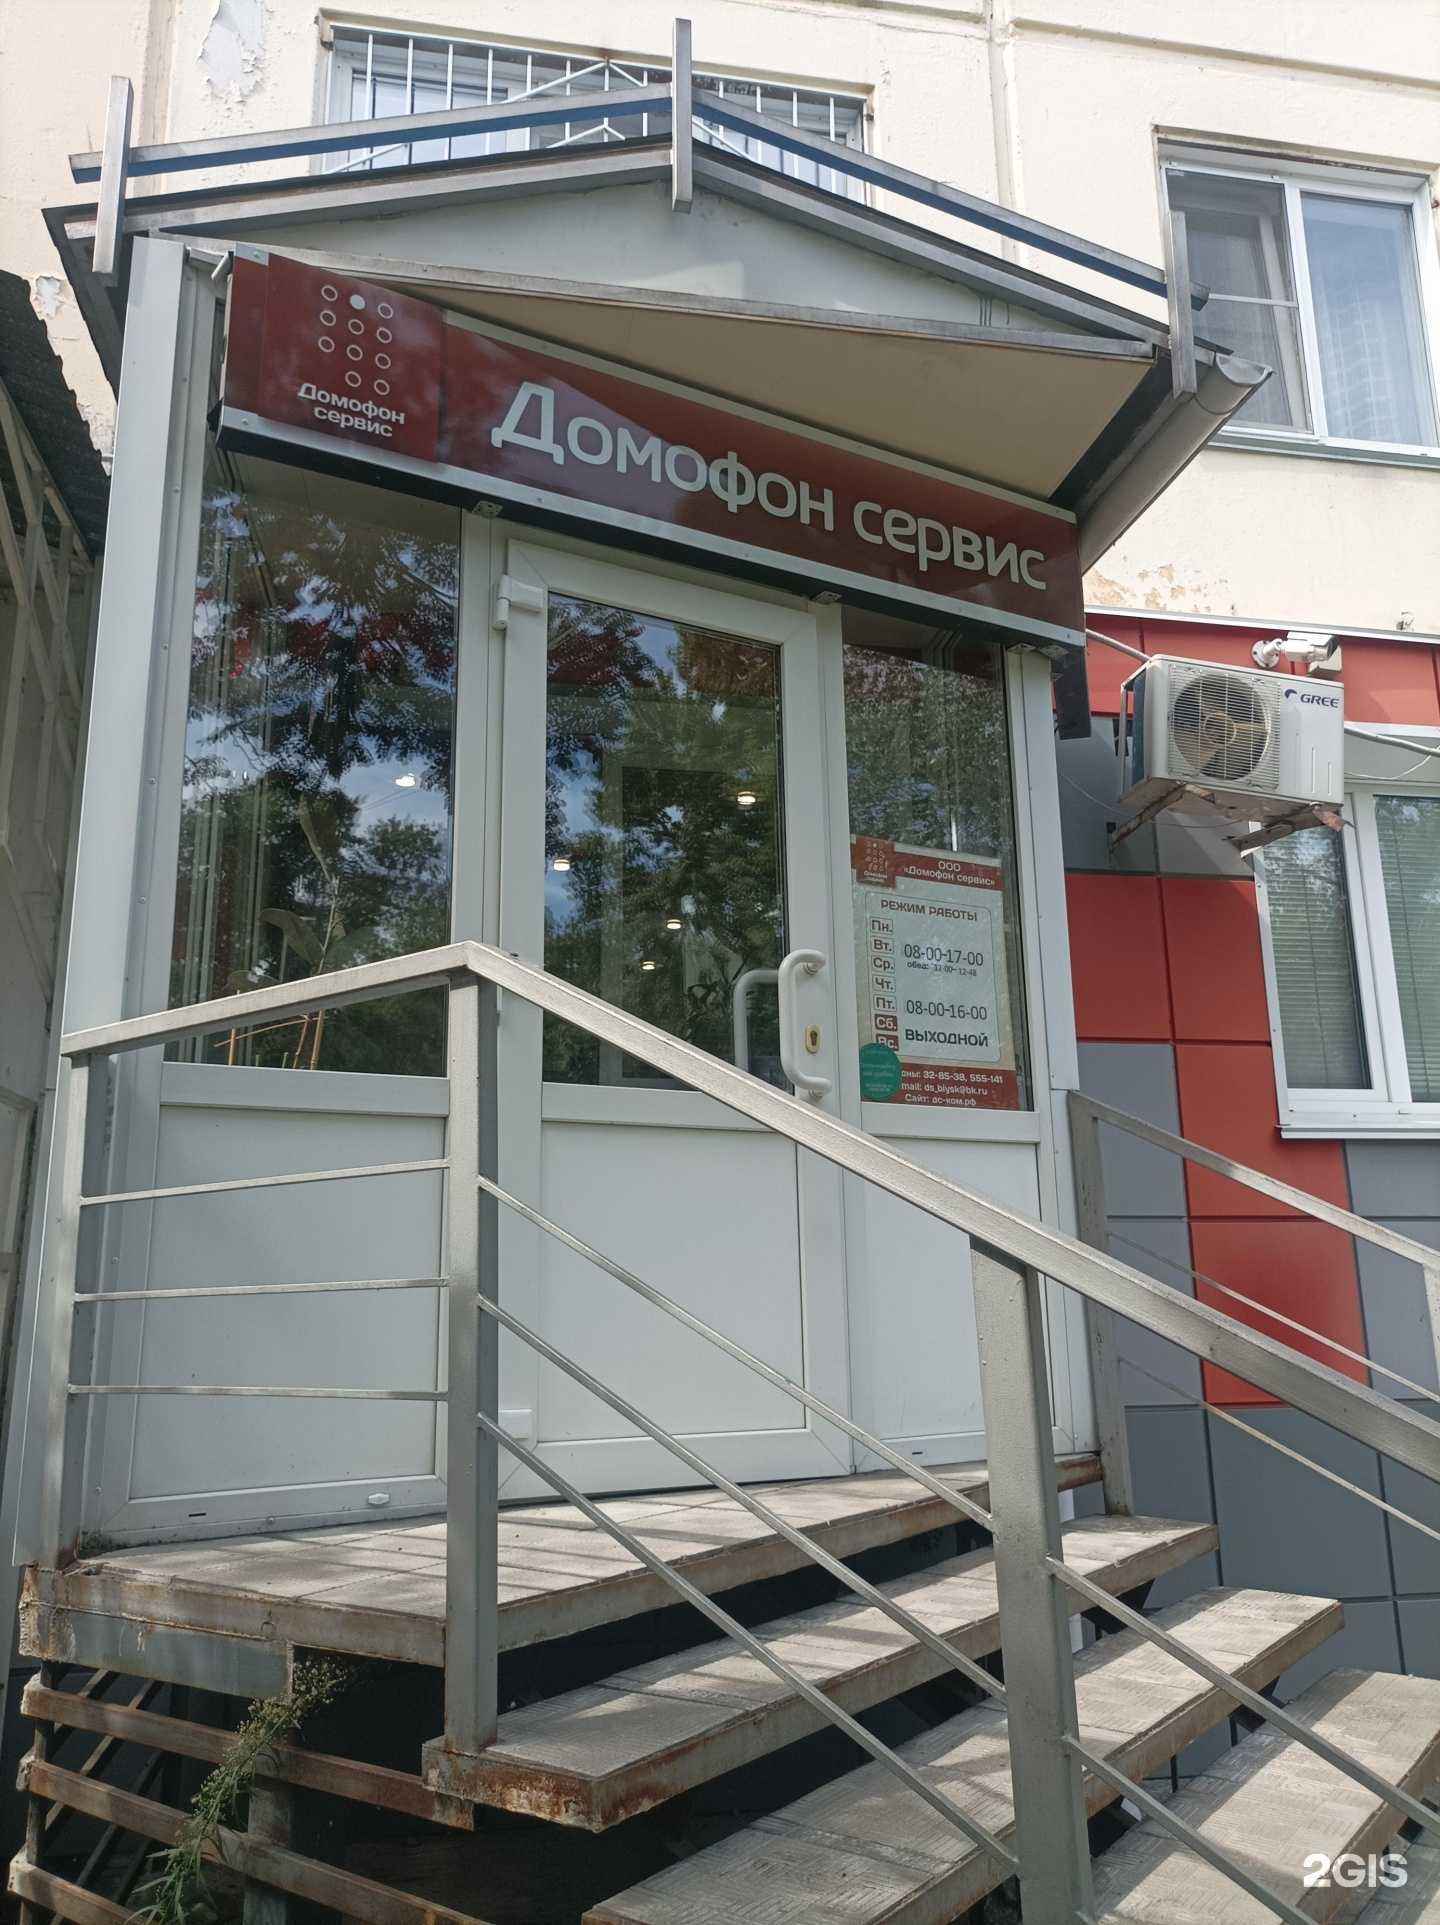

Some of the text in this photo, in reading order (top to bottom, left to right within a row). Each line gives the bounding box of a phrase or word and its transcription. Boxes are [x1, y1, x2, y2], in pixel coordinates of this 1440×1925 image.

[297, 382, 405, 425] Домофон
[313, 406, 393, 438] сервис
[491, 381, 1047, 590] Домофон сервис
[1300, 693, 1340, 709] GREE
[938, 860, 961, 873] ООО
[880, 899, 978, 922] РЕЖИМ РАБОТЫ
[871, 919, 893, 933] Пн.
[873, 938, 893, 952] Вт.
[903, 944, 984, 967] 08-00-17-00
[873, 957, 895, 971] Ср.
[874, 977, 895, 991] Чт.
[875, 996, 896, 1010] Пт.
[906, 999, 988, 1020] 08-00-16-00
[876, 1015, 897, 1030] Сб.
[905, 1028, 989, 1048] ВЫХОДНОЙ
[905, 1093, 930, 1105] Сайт:
